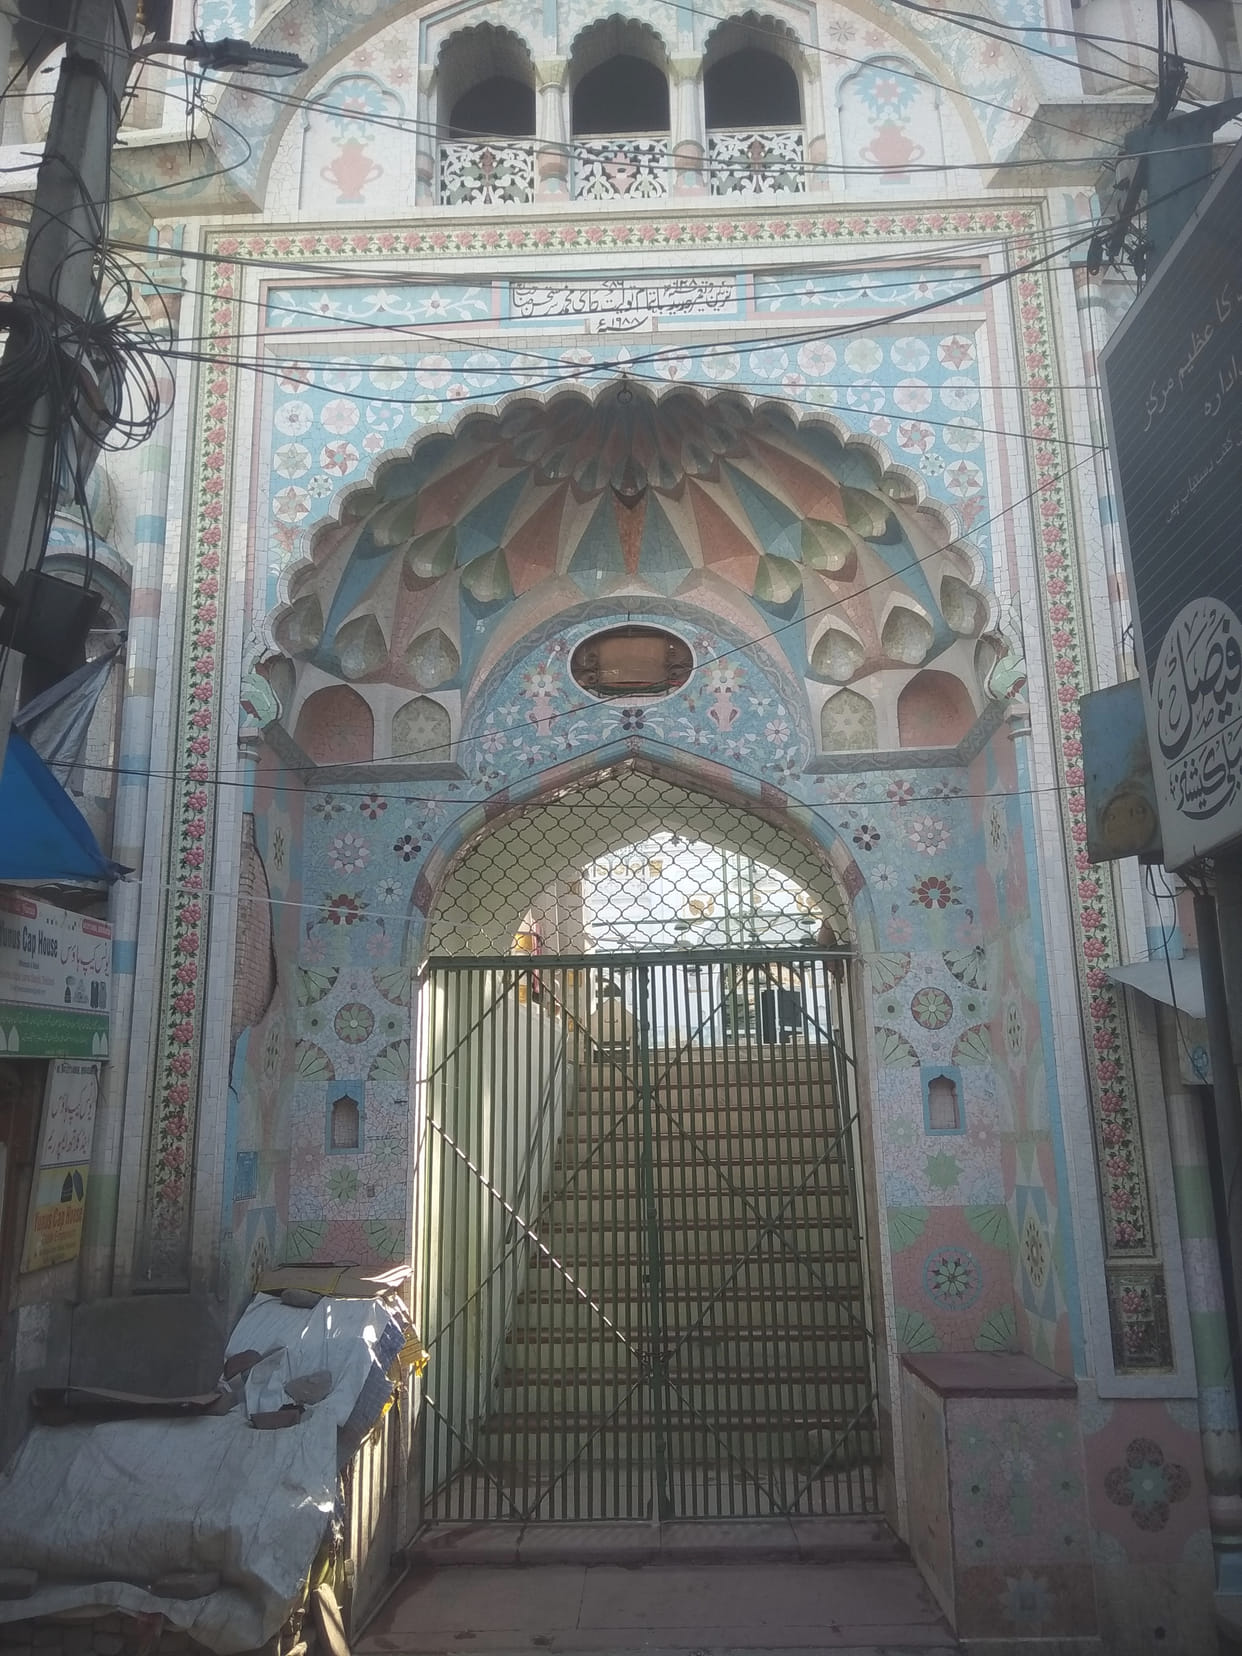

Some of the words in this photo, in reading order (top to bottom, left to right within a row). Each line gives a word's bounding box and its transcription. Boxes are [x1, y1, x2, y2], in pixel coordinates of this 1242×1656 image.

[1178, 324, 1214, 392] عظیم
[1143, 377, 1174, 432] مرکز
[22, 926, 37, 959] Cap
[38, 929, 58, 958] House
